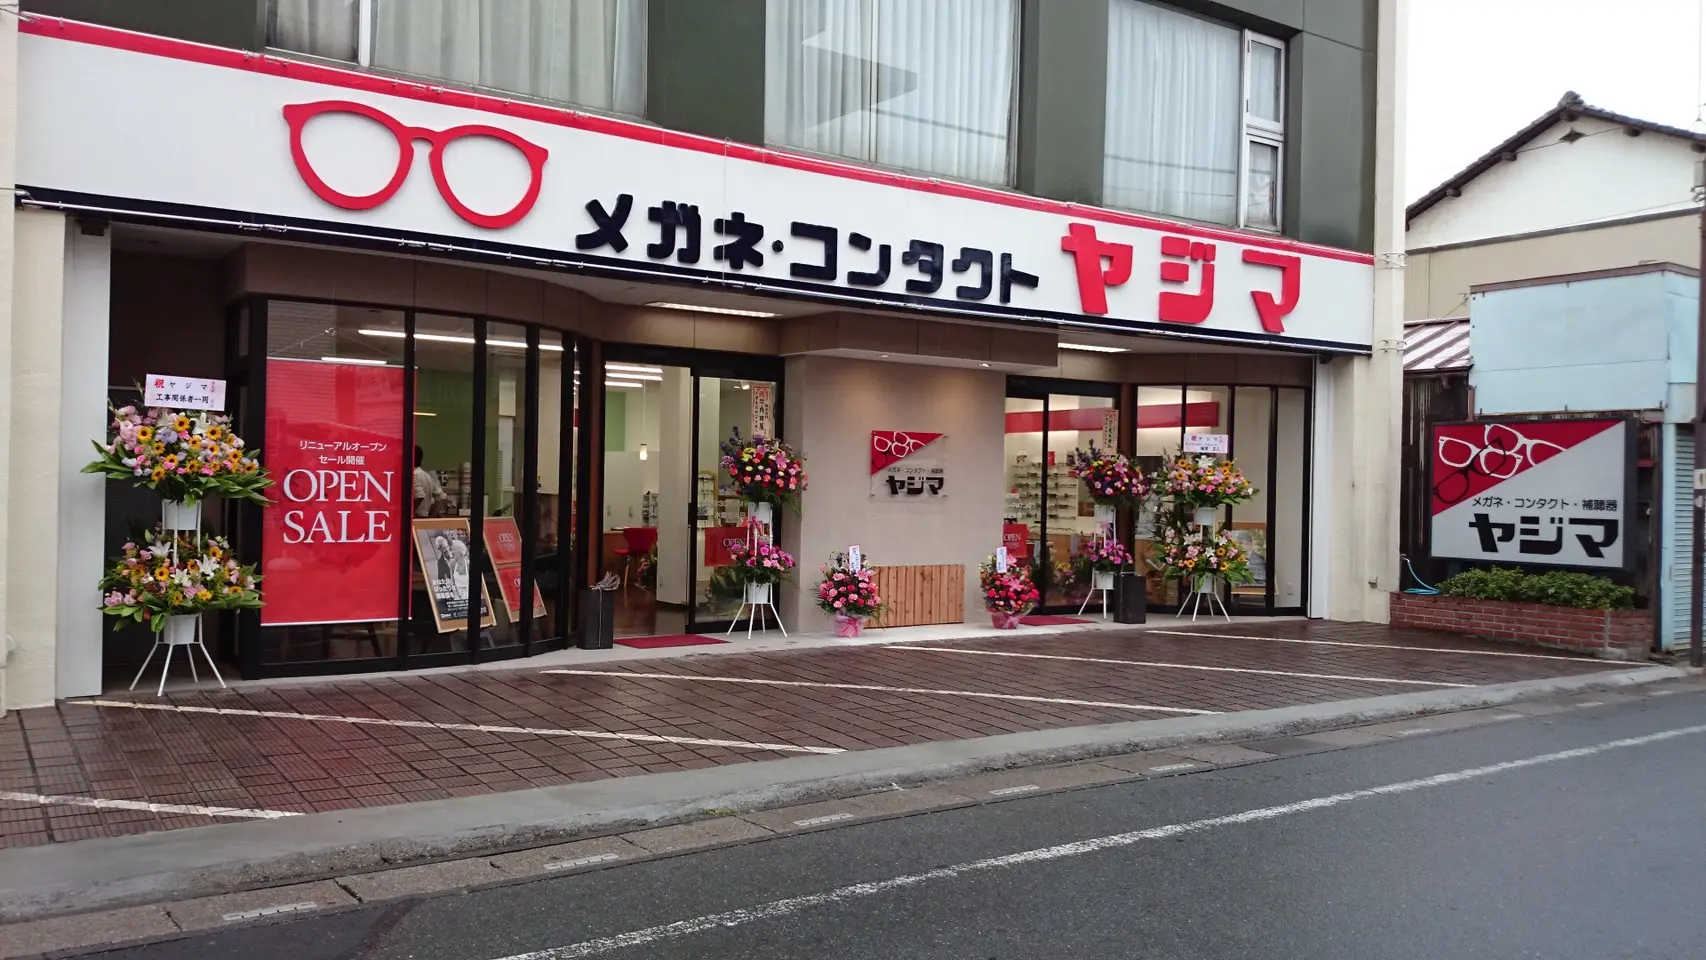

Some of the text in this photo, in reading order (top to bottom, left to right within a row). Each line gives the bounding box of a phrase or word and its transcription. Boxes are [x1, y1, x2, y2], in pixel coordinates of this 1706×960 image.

[575, 193, 1303, 334] メガネ・コンタクト ヤジマ
[153, 378, 165, 389] 祝
[155, 393, 209, 404] 工事関係者一同
[300, 440, 388, 452] リニューアルオープン
[318, 454, 365, 466] セール開催
[283, 468, 395, 503] OPEN
[885, 475, 945, 495] ヤジマ
[1472, 496, 1618, 512] メガネ・コンタクト・補聴器
[282, 510, 392, 544] SALE
[1003, 533, 1020, 541] OPEN
[1468, 512, 1619, 559] ヤジマ
